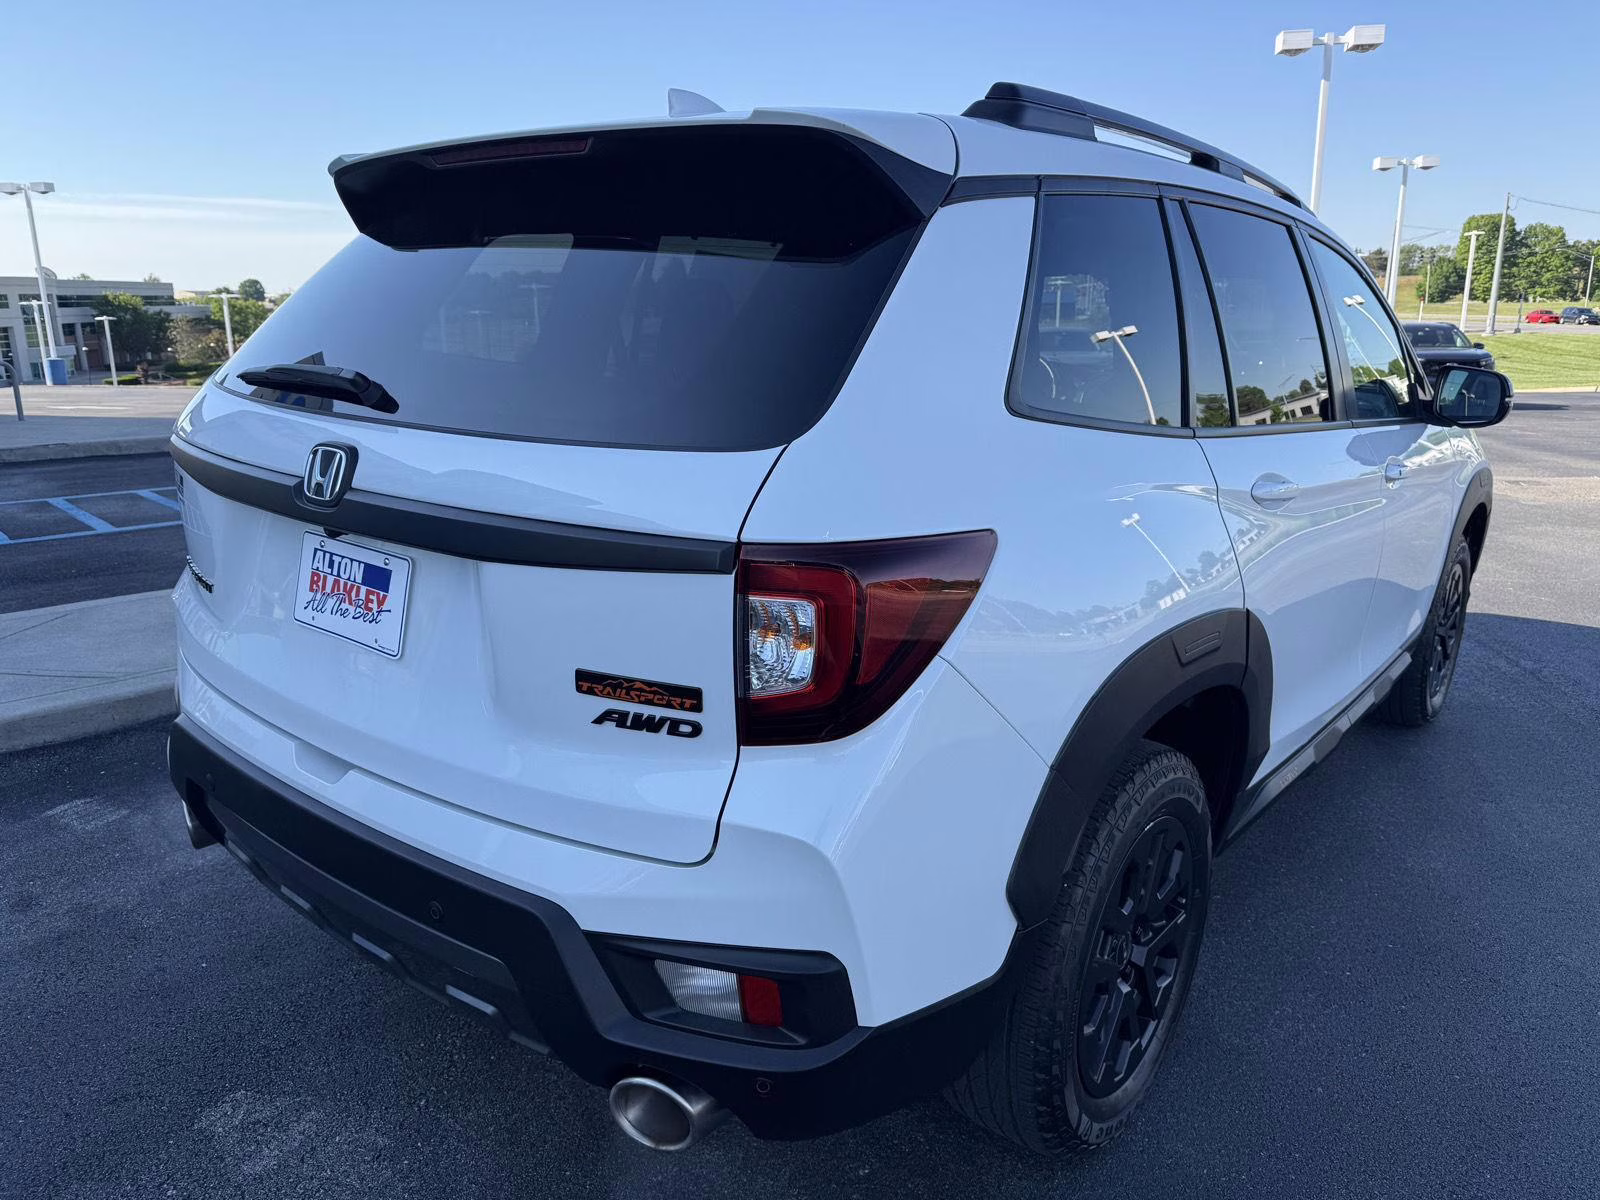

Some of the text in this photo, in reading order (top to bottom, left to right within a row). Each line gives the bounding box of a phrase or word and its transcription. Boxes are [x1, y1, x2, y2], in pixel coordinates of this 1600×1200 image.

[312, 550, 365, 584] ALTON
[304, 589, 392, 624] All The Best
[309, 571, 389, 613] BLAKLEY
[578, 681, 698, 710] TRAILSPORT
[590, 708, 703, 738] AWD
